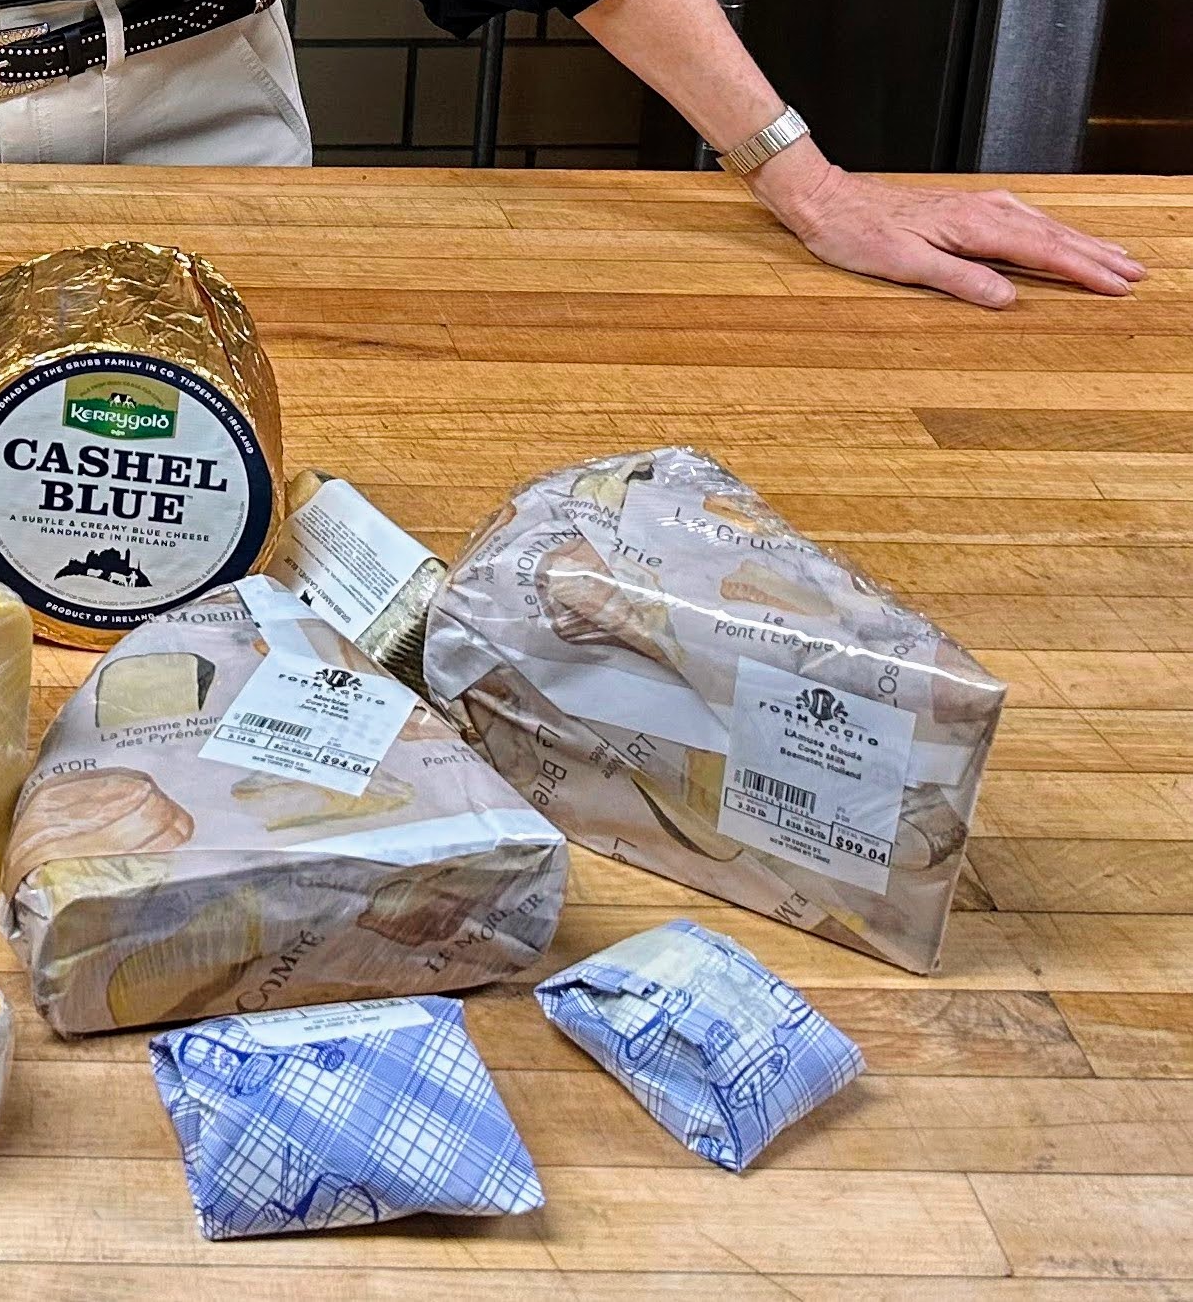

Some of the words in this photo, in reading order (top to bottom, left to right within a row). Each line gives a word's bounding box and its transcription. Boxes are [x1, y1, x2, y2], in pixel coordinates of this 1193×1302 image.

[28, 374, 41, 386] BY
[42, 365, 64, 378] THE
[65, 358, 102, 370] GRUBB
[104, 358, 143, 369] FAMILY
[145, 362, 157, 373] IN
[159, 366, 177, 380] CO.
[179, 375, 228, 417] TIPPERARY,
[226, 415, 255, 455] IRELAND
[70, 403, 170, 430] Kerrygold
[3, 438, 229, 493] CASHEL
[38, 479, 186, 525] BLUE
[9, 514, 17, 522] A
[22, 515, 64, 527] SUBTLE
[80, 521, 128, 533] CREAMY
[132, 526, 161, 537] BLUE
[165, 531, 210, 542] CHEESE
[40, 526, 105, 540] HANDMADE
[110, 533, 122, 542] IN
[126, 535, 177, 548] IRELAND
[515, 540, 550, 588] MONT
[316, 588, 335, 608] FAMILY
[524, 593, 542, 620] Le
[45, 601, 91, 620] PRODUCT
[94, 614, 109, 623] OF
[111, 612, 155, 624] IRELAND
[762, 610, 785, 626] Le
[713, 619, 755, 642] Pont
[278, 672, 386, 706] FORMAGGIO
[312, 693, 350, 708] Morbier
[305, 698, 329, 709] Cow's
[330, 704, 349, 714] Milk
[320, 708, 349, 721] France
[100, 732, 118, 743] La
[122, 720, 181, 738] Tomme
[185, 715, 222, 728] Noir
[758, 700, 880, 747] FORMAGGIO
[115, 735, 144, 750] des
[148, 726, 213, 746] Pyrénée
[784, 727, 825, 749] L'Amuse
[829, 743, 863, 762] Gouda
[320, 753, 371, 776] $94.04
[421, 753, 459, 768] Pont
[797, 742, 824, 758] Cow's
[825, 752, 847, 766] Milk
[51, 758, 98, 775] d'OR
[826, 762, 862, 781] Holland
[532, 759, 568, 807] Brie
[835, 835, 887, 865] $99.04
